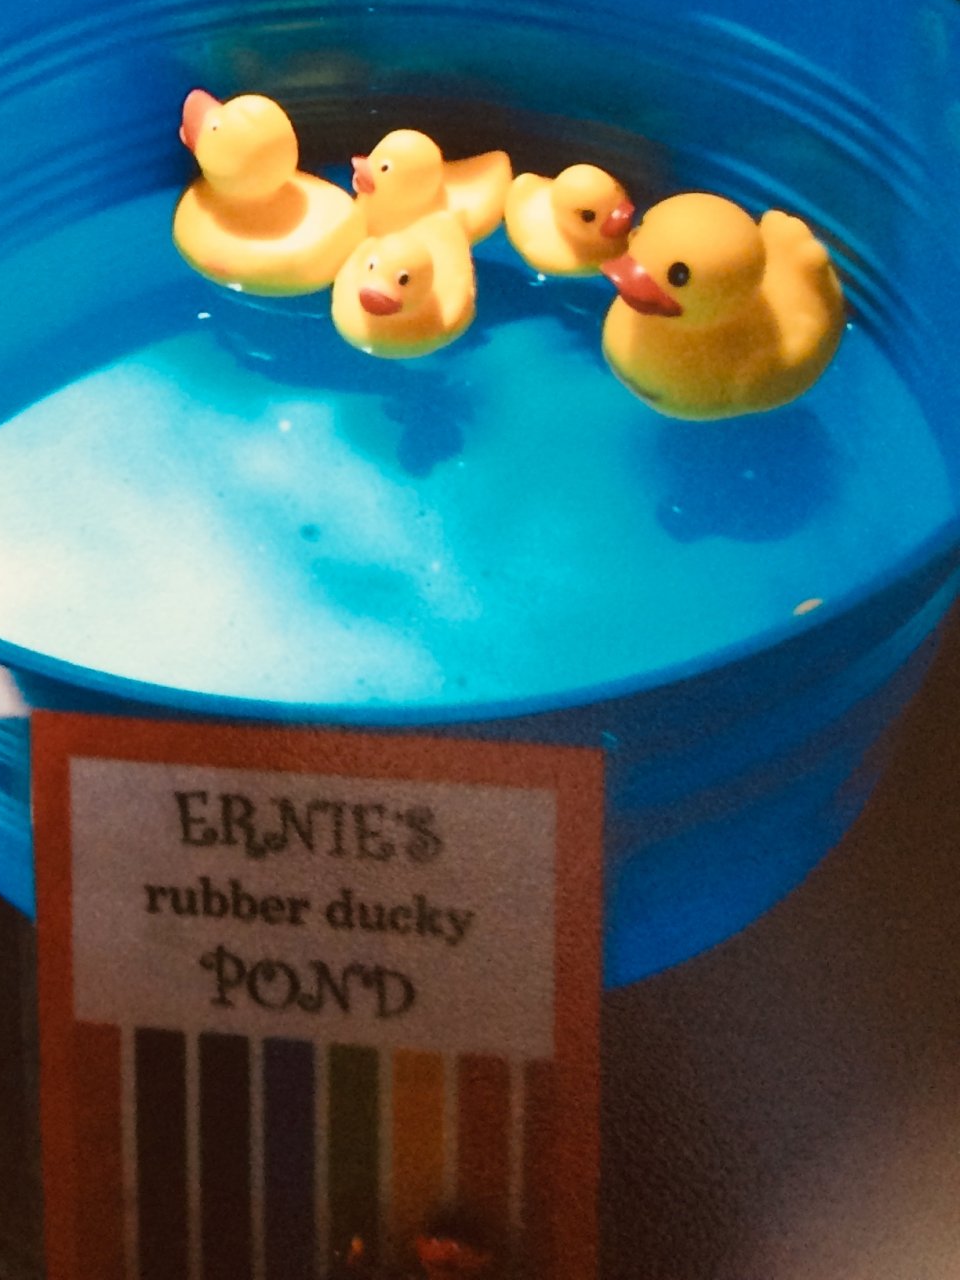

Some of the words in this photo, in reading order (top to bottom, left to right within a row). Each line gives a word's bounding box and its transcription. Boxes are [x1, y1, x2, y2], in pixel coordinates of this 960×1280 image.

[144, 877, 310, 926] rubber
[326, 888, 474, 945] ducky
[199, 944, 417, 1018] POND
